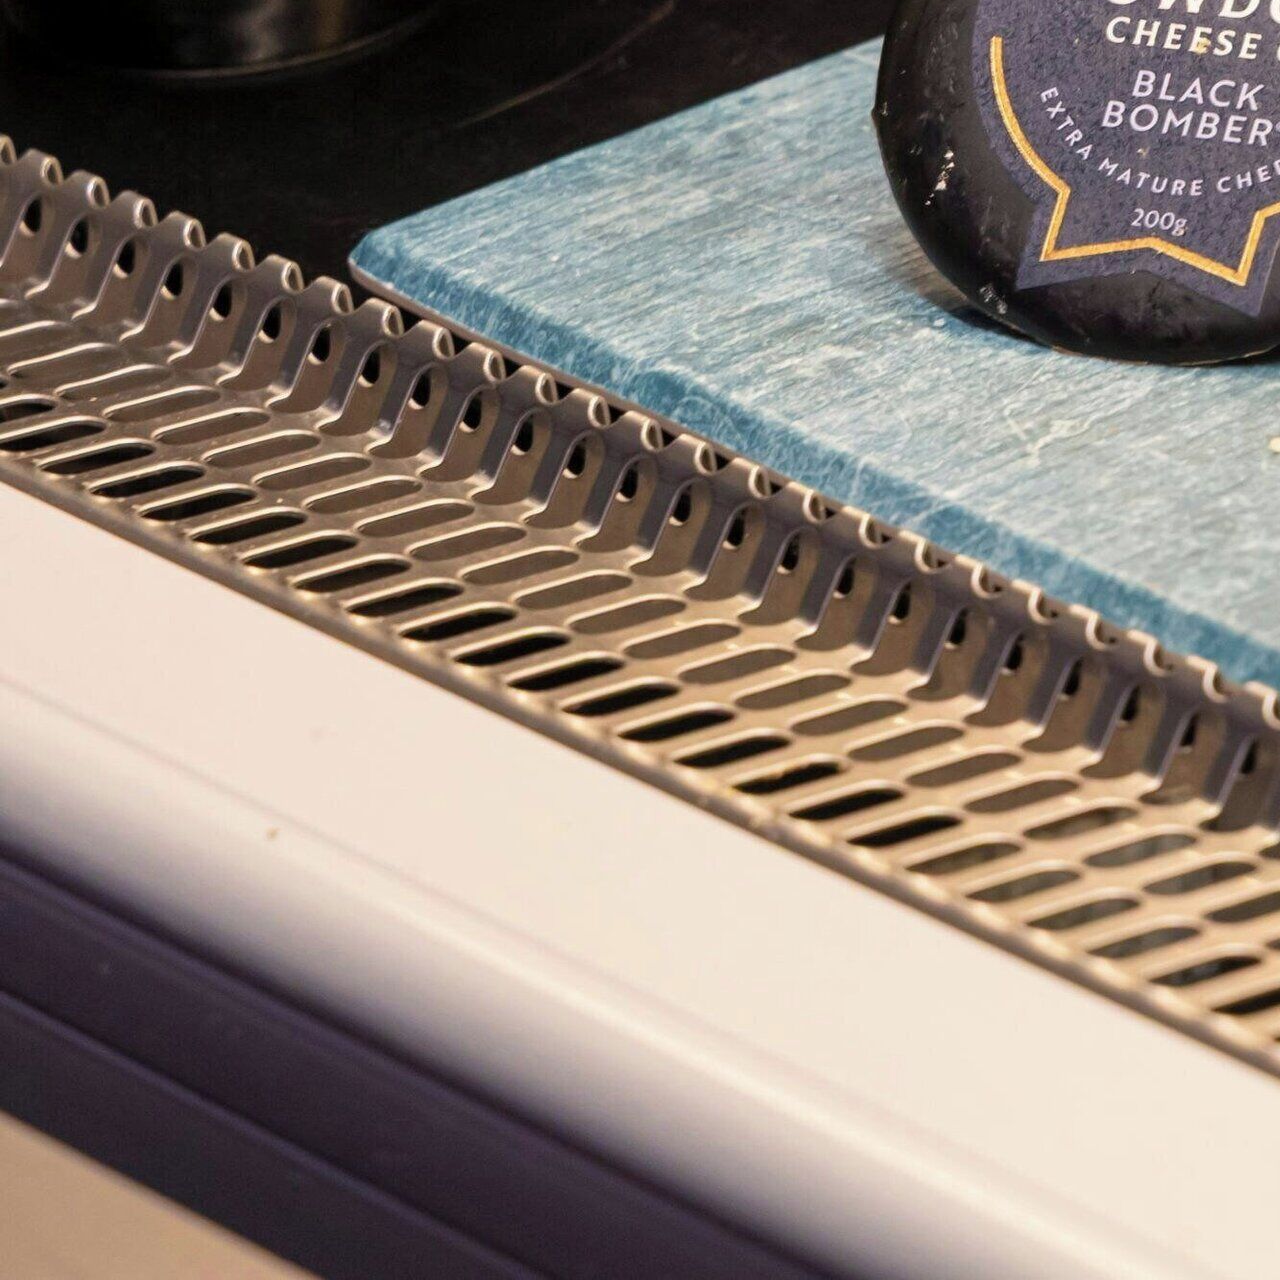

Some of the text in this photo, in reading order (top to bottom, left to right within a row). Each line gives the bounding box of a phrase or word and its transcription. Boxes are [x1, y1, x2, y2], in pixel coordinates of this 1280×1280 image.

[1105, 16, 1263, 60] CHEESE
[1131, 69, 1265, 111] BLACK
[1040, 86, 1094, 161] EXTRA
[1097, 157, 1204, 196] MATURE
[1130, 207, 1188, 238] 200g
